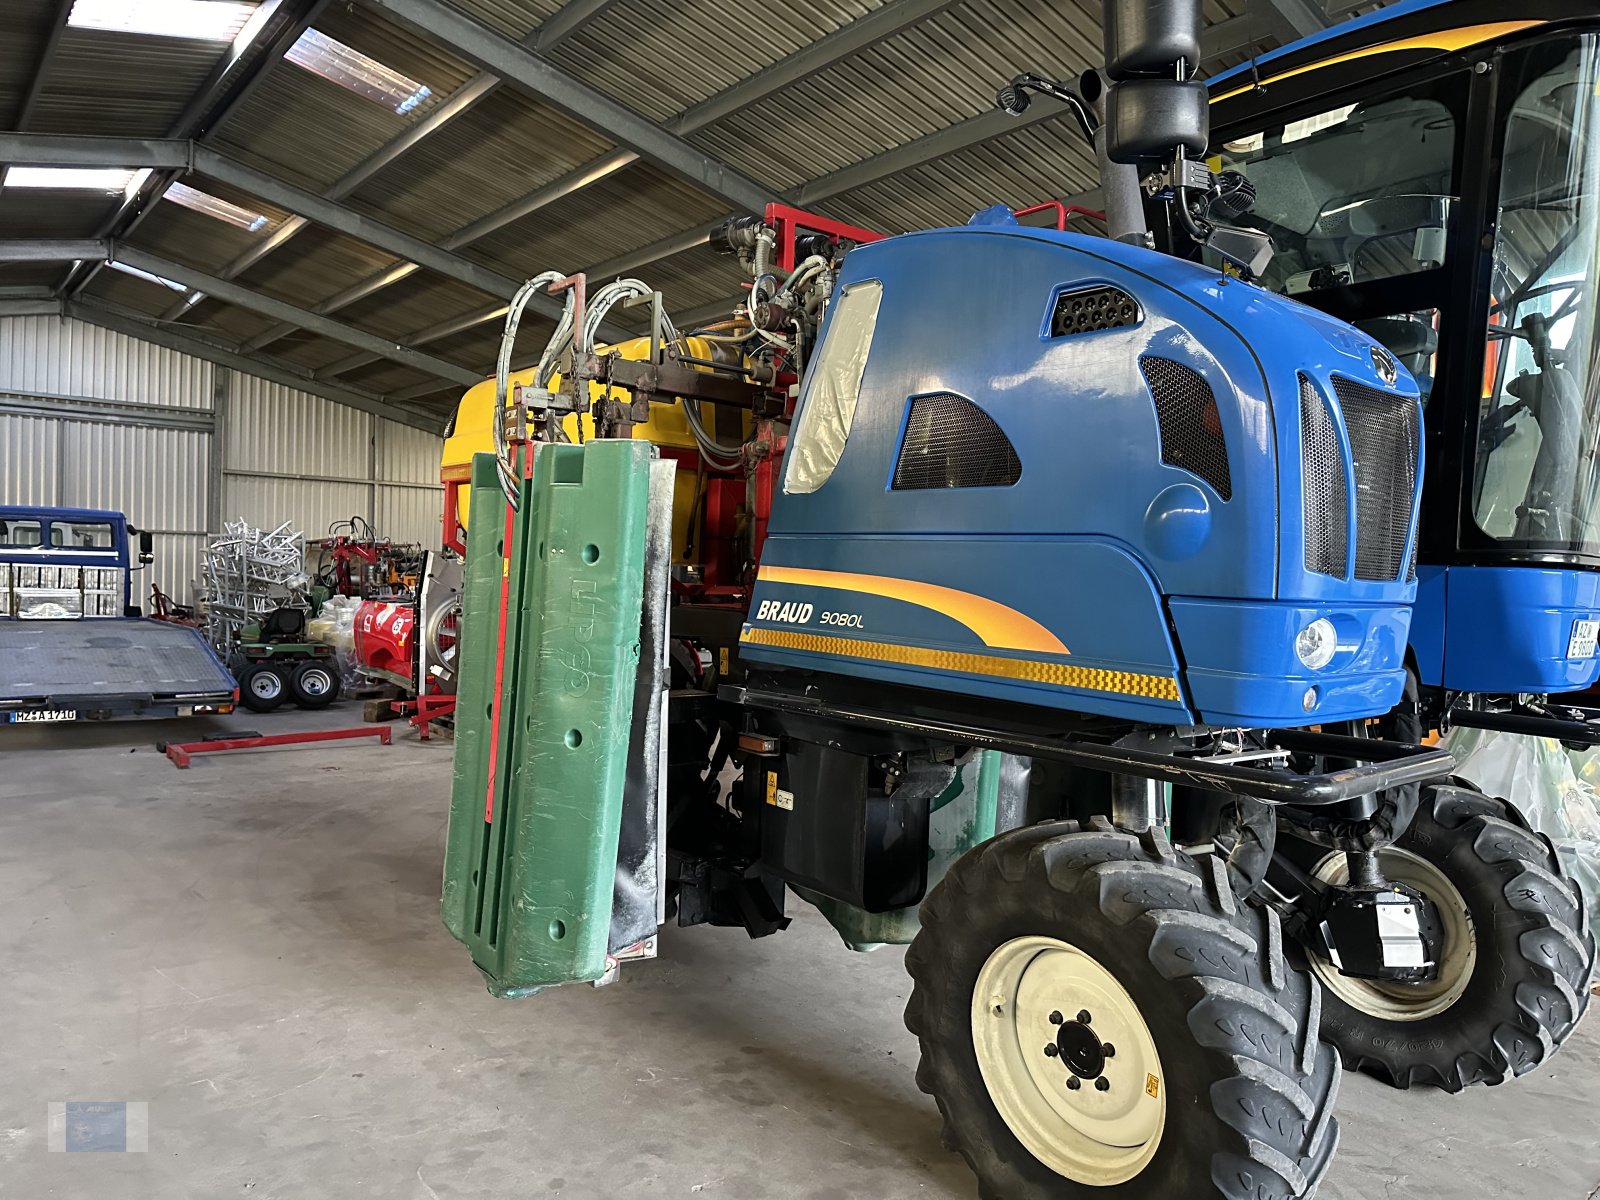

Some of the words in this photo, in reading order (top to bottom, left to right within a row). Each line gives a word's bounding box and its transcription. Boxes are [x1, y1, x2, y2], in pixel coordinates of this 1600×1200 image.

[756, 600, 814, 624] BRAUD
[819, 611, 864, 629] 9080L
[17, 712, 31, 722] MZ
[47, 710, 75, 720] 1710
